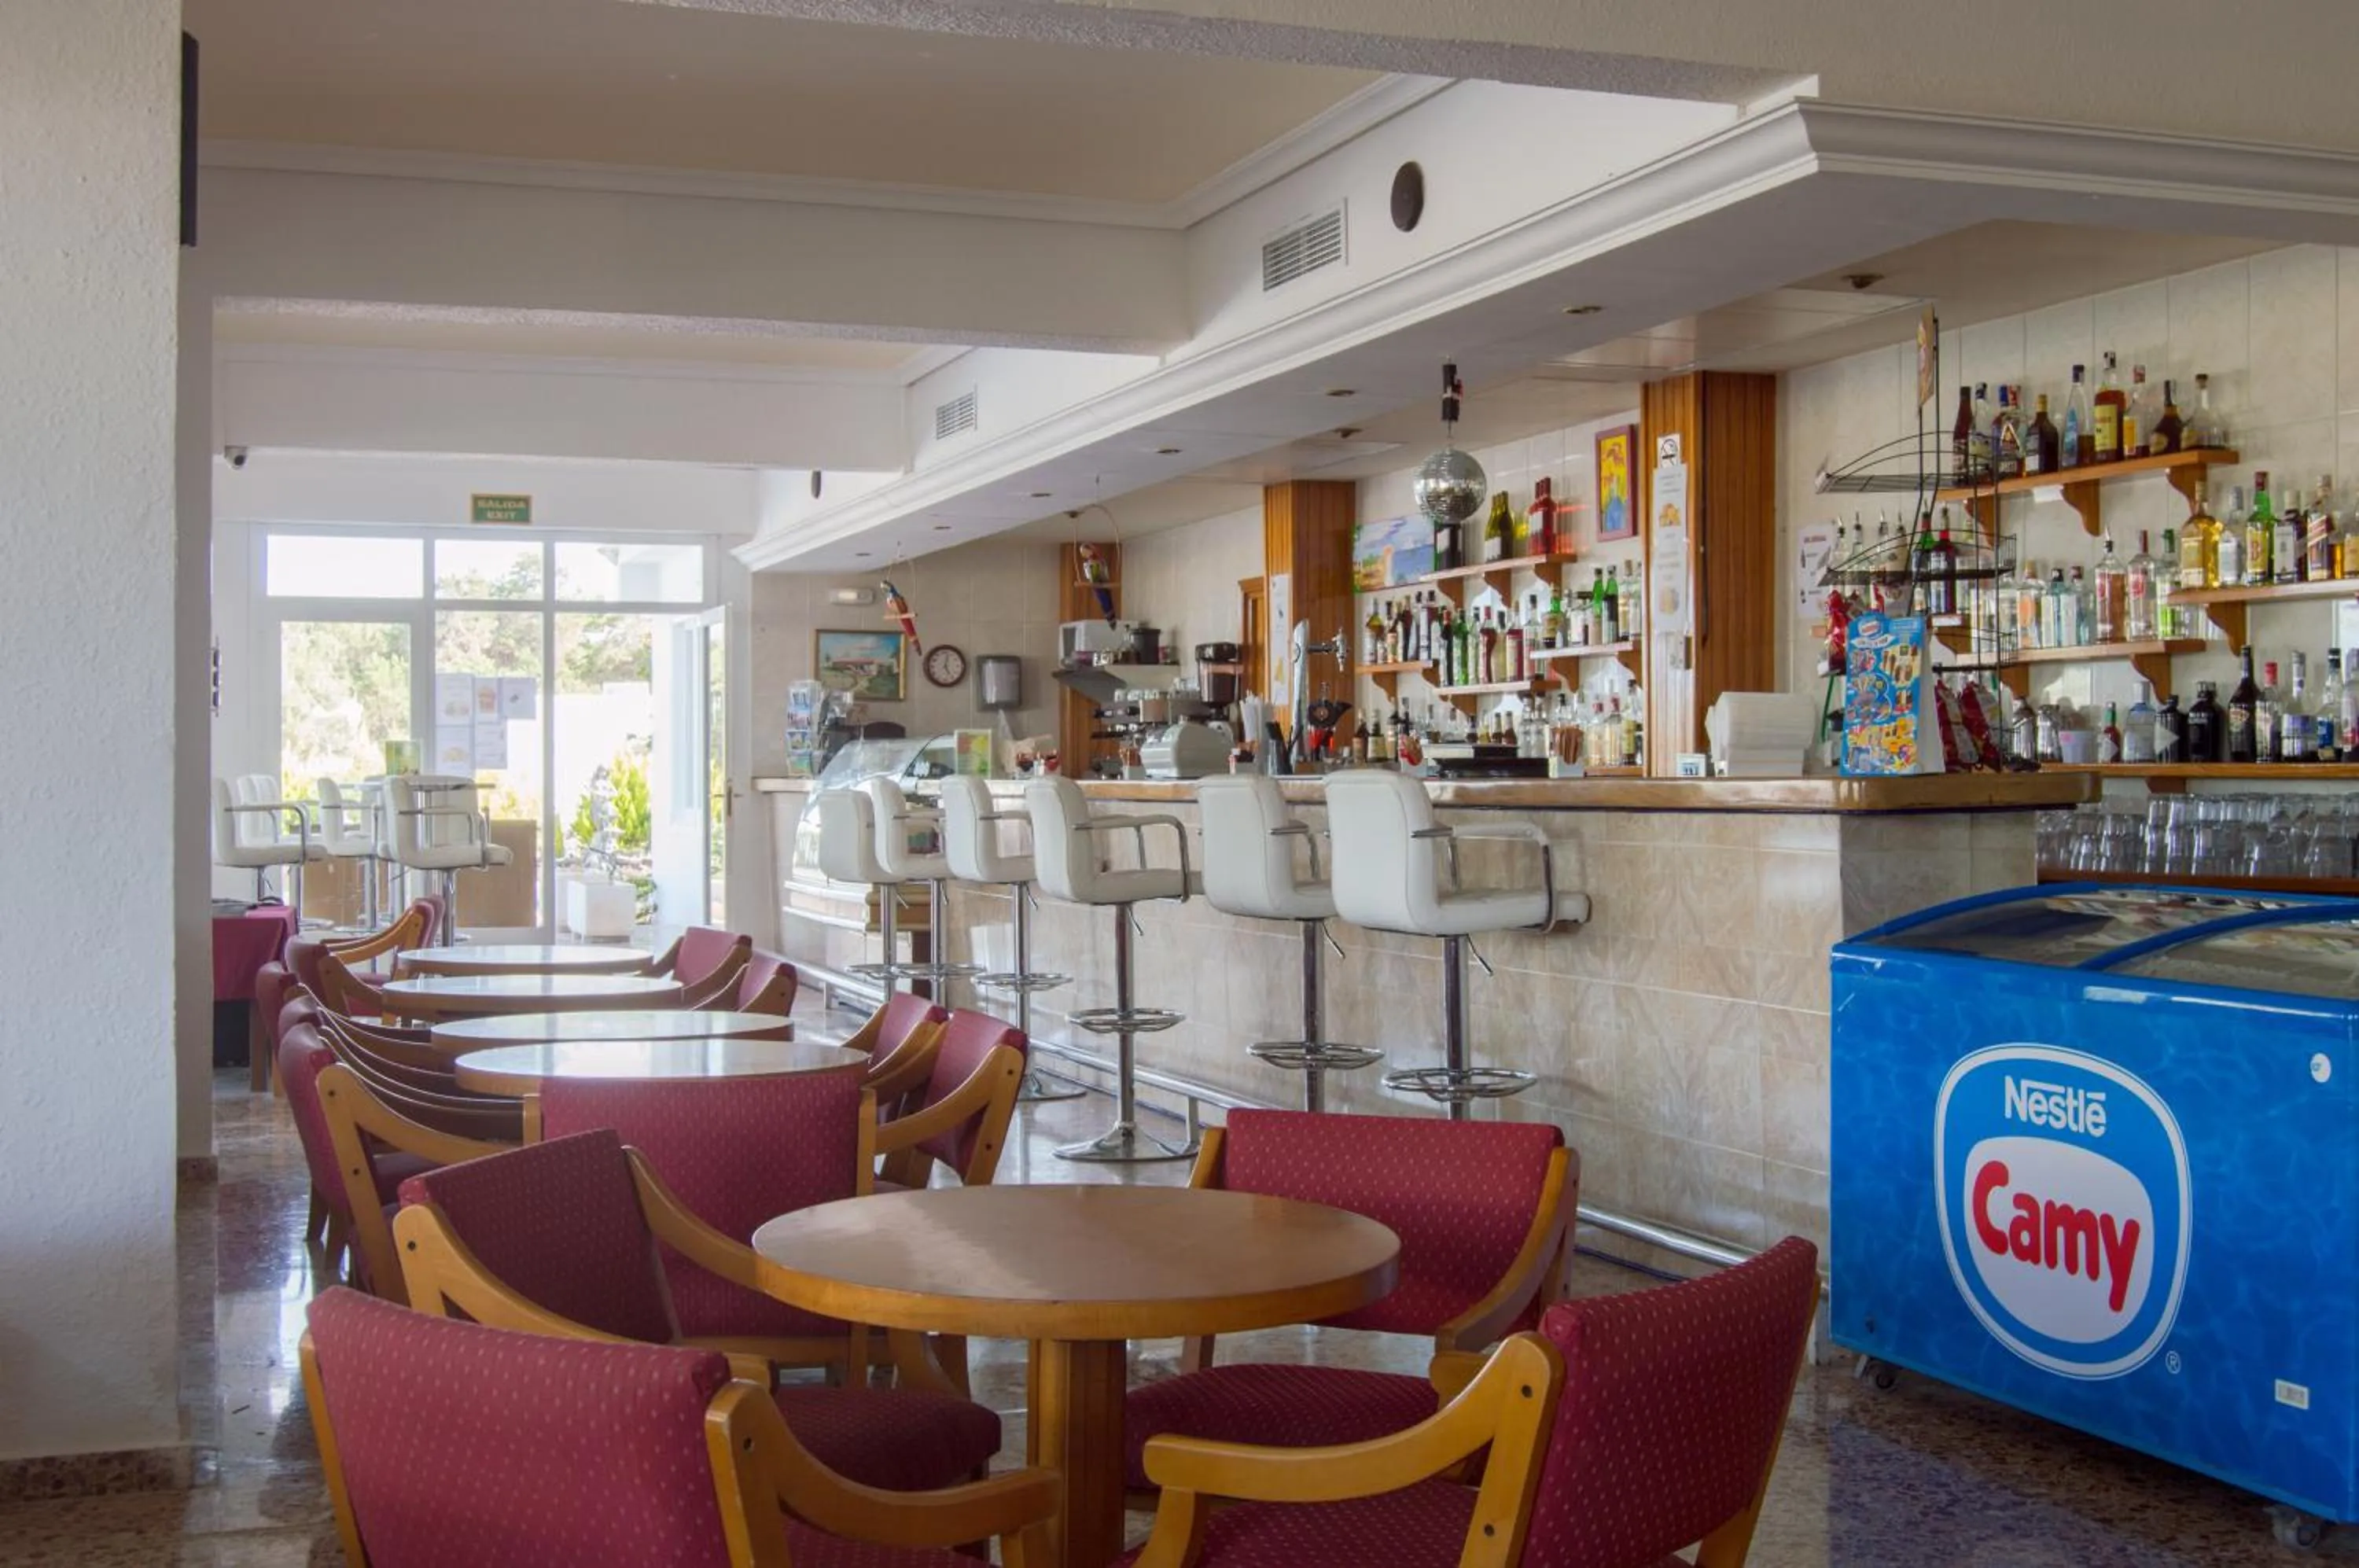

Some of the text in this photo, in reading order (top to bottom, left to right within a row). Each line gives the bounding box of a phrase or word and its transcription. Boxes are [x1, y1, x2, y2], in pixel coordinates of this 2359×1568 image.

[477, 499, 526, 510] SALIDA
[487, 510, 517, 521] EXIT
[1972, 1160, 2140, 1312] Camy
